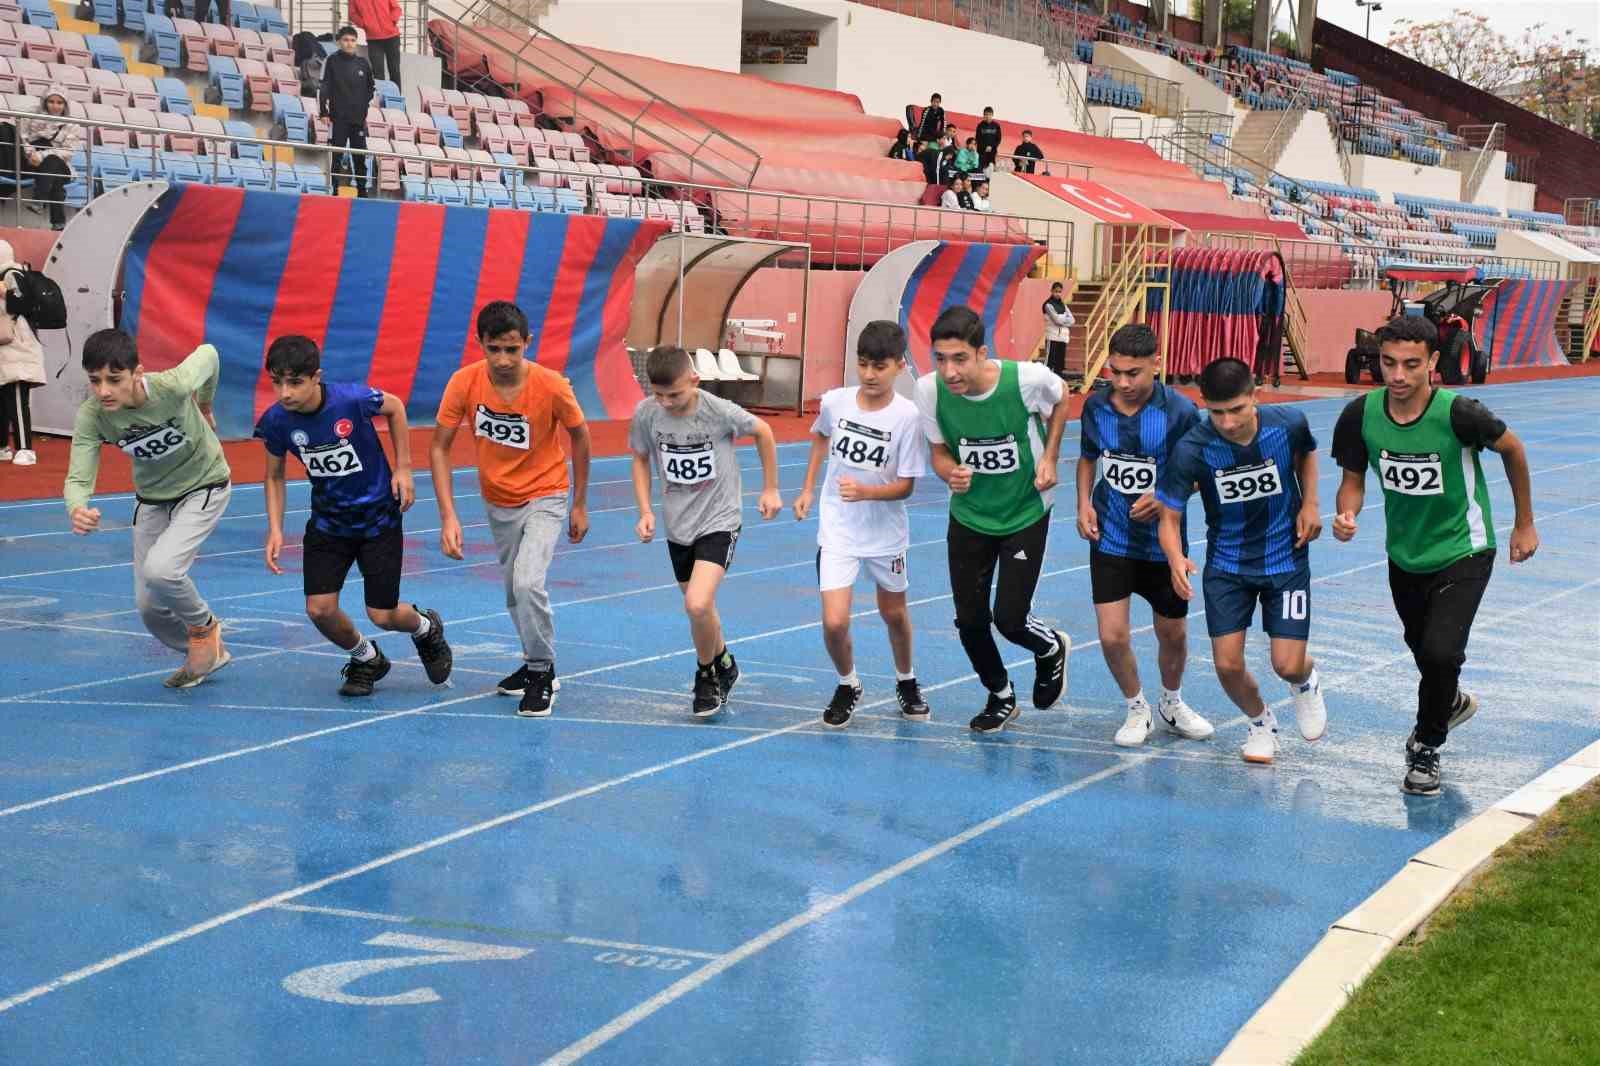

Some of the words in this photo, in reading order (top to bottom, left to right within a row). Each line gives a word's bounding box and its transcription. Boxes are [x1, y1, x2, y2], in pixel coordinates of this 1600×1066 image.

[133, 431, 184, 458] 486
[479, 420, 526, 444] 493
[309, 451, 359, 474] 462
[836, 436, 885, 467] 484
[965, 448, 1016, 470] 483
[667, 456, 713, 480] 485
[1106, 463, 1154, 490] 469
[1385, 465, 1440, 490] 492
[1220, 473, 1277, 500] 398
[1282, 590, 1307, 620] 10
